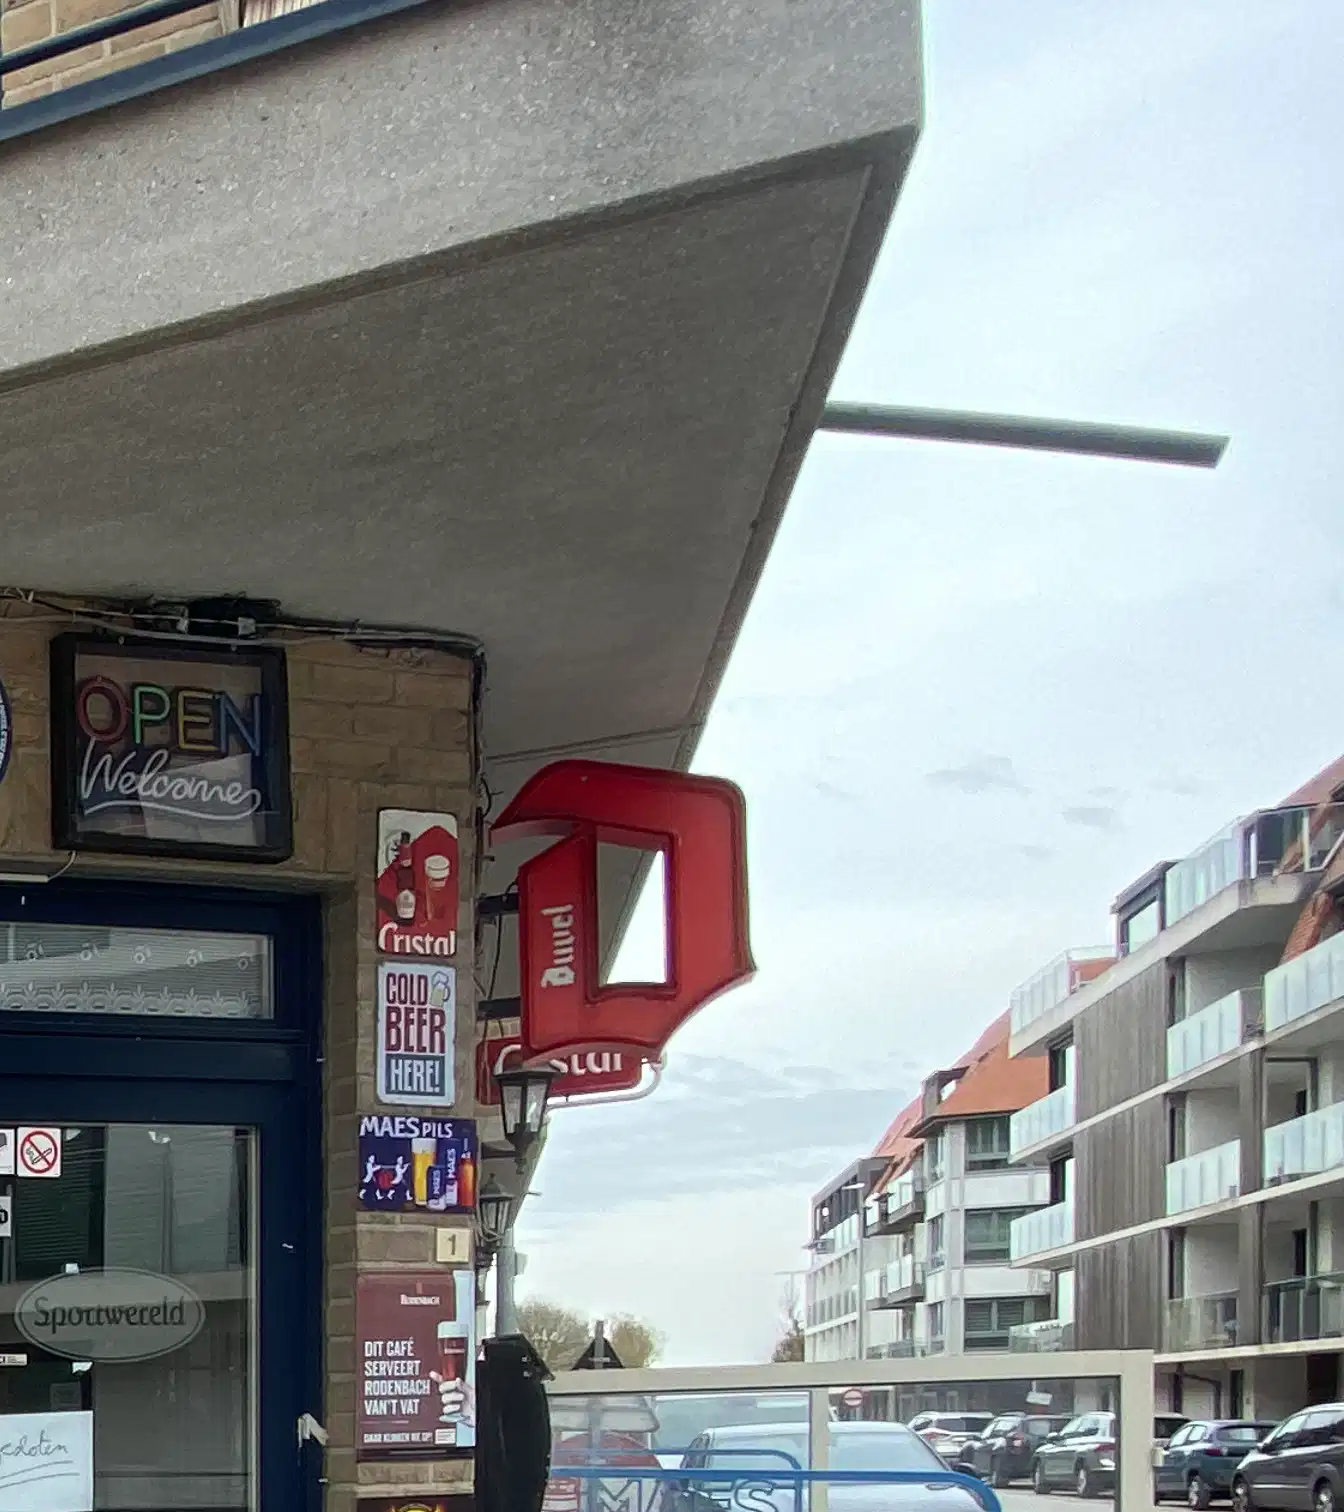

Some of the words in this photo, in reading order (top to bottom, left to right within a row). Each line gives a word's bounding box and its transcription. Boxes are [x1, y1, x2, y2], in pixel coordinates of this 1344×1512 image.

[76, 675, 262, 756] OPEN
[81, 736, 261, 812] Welcome
[378, 921, 455, 957] Cristal
[540, 904, 576, 988] Duvel
[386, 973, 429, 1006] COLD
[385, 1006, 446, 1054] BEER
[390, 1058, 441, 1094] HERE!
[359, 1116, 421, 1138] MAES
[422, 1122, 453, 1138] PILS
[448, 1234, 457, 1255] 1
[34, 1296, 187, 1335] Sportwereld
[364, 1341, 383, 1357] DIT
[387, 1336, 415, 1357] CAFÉ
[364, 1360, 421, 1376] SERVEERT
[364, 1380, 430, 1396] RODENBACH
[364, 1399, 397, 1415] VAN'T
[400, 1399, 420, 1415] VAT
